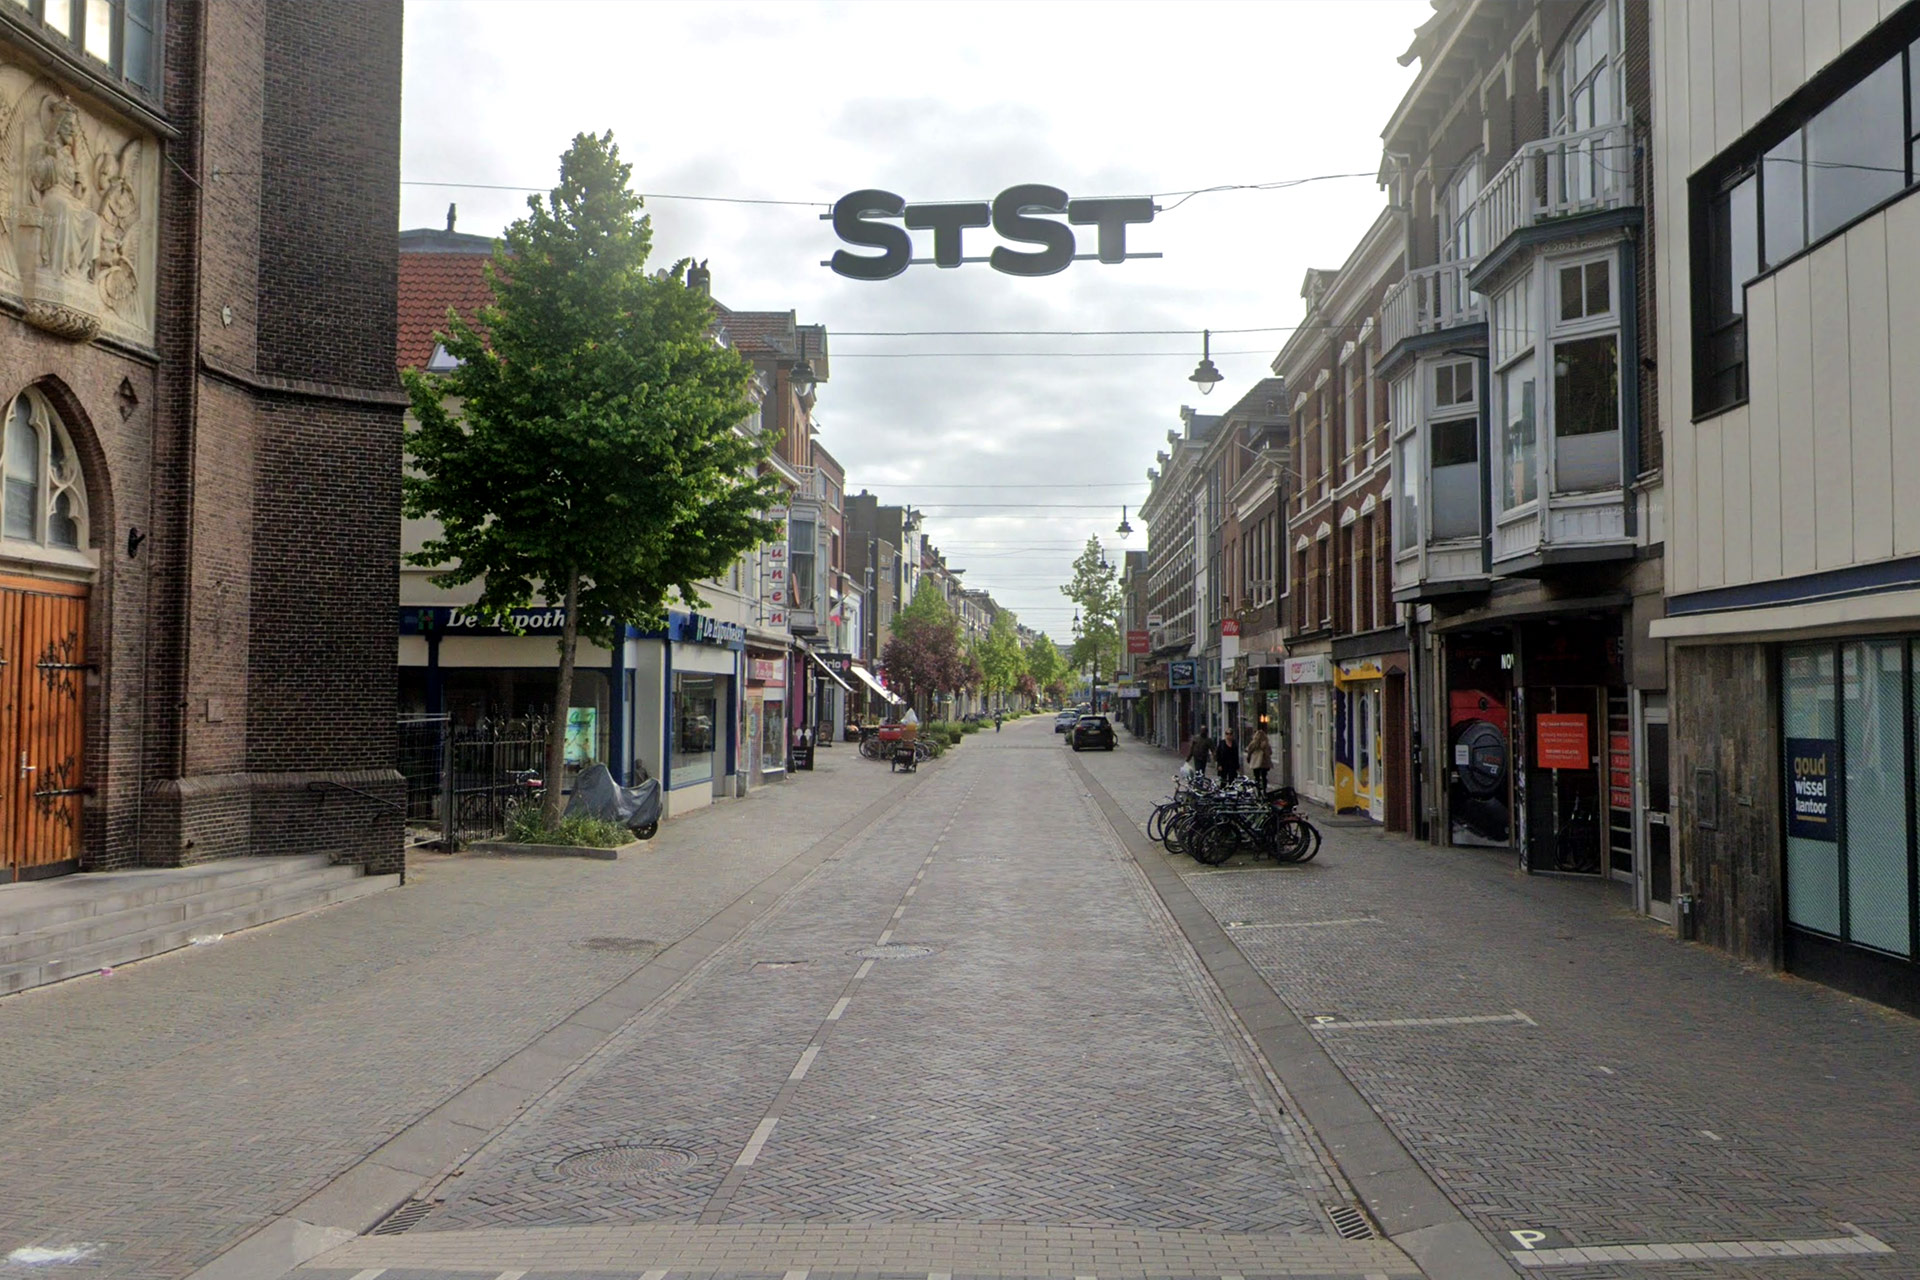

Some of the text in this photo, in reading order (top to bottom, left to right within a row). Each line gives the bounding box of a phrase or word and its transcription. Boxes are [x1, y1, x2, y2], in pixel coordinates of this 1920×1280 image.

[831, 183, 1154, 281] STST
[447, 608, 477, 627] De
[1223, 620, 1239, 633] illy
[1794, 753, 1826, 778] goud
[1794, 777, 1827, 796] wissel
[1509, 1229, 1546, 1250] P
